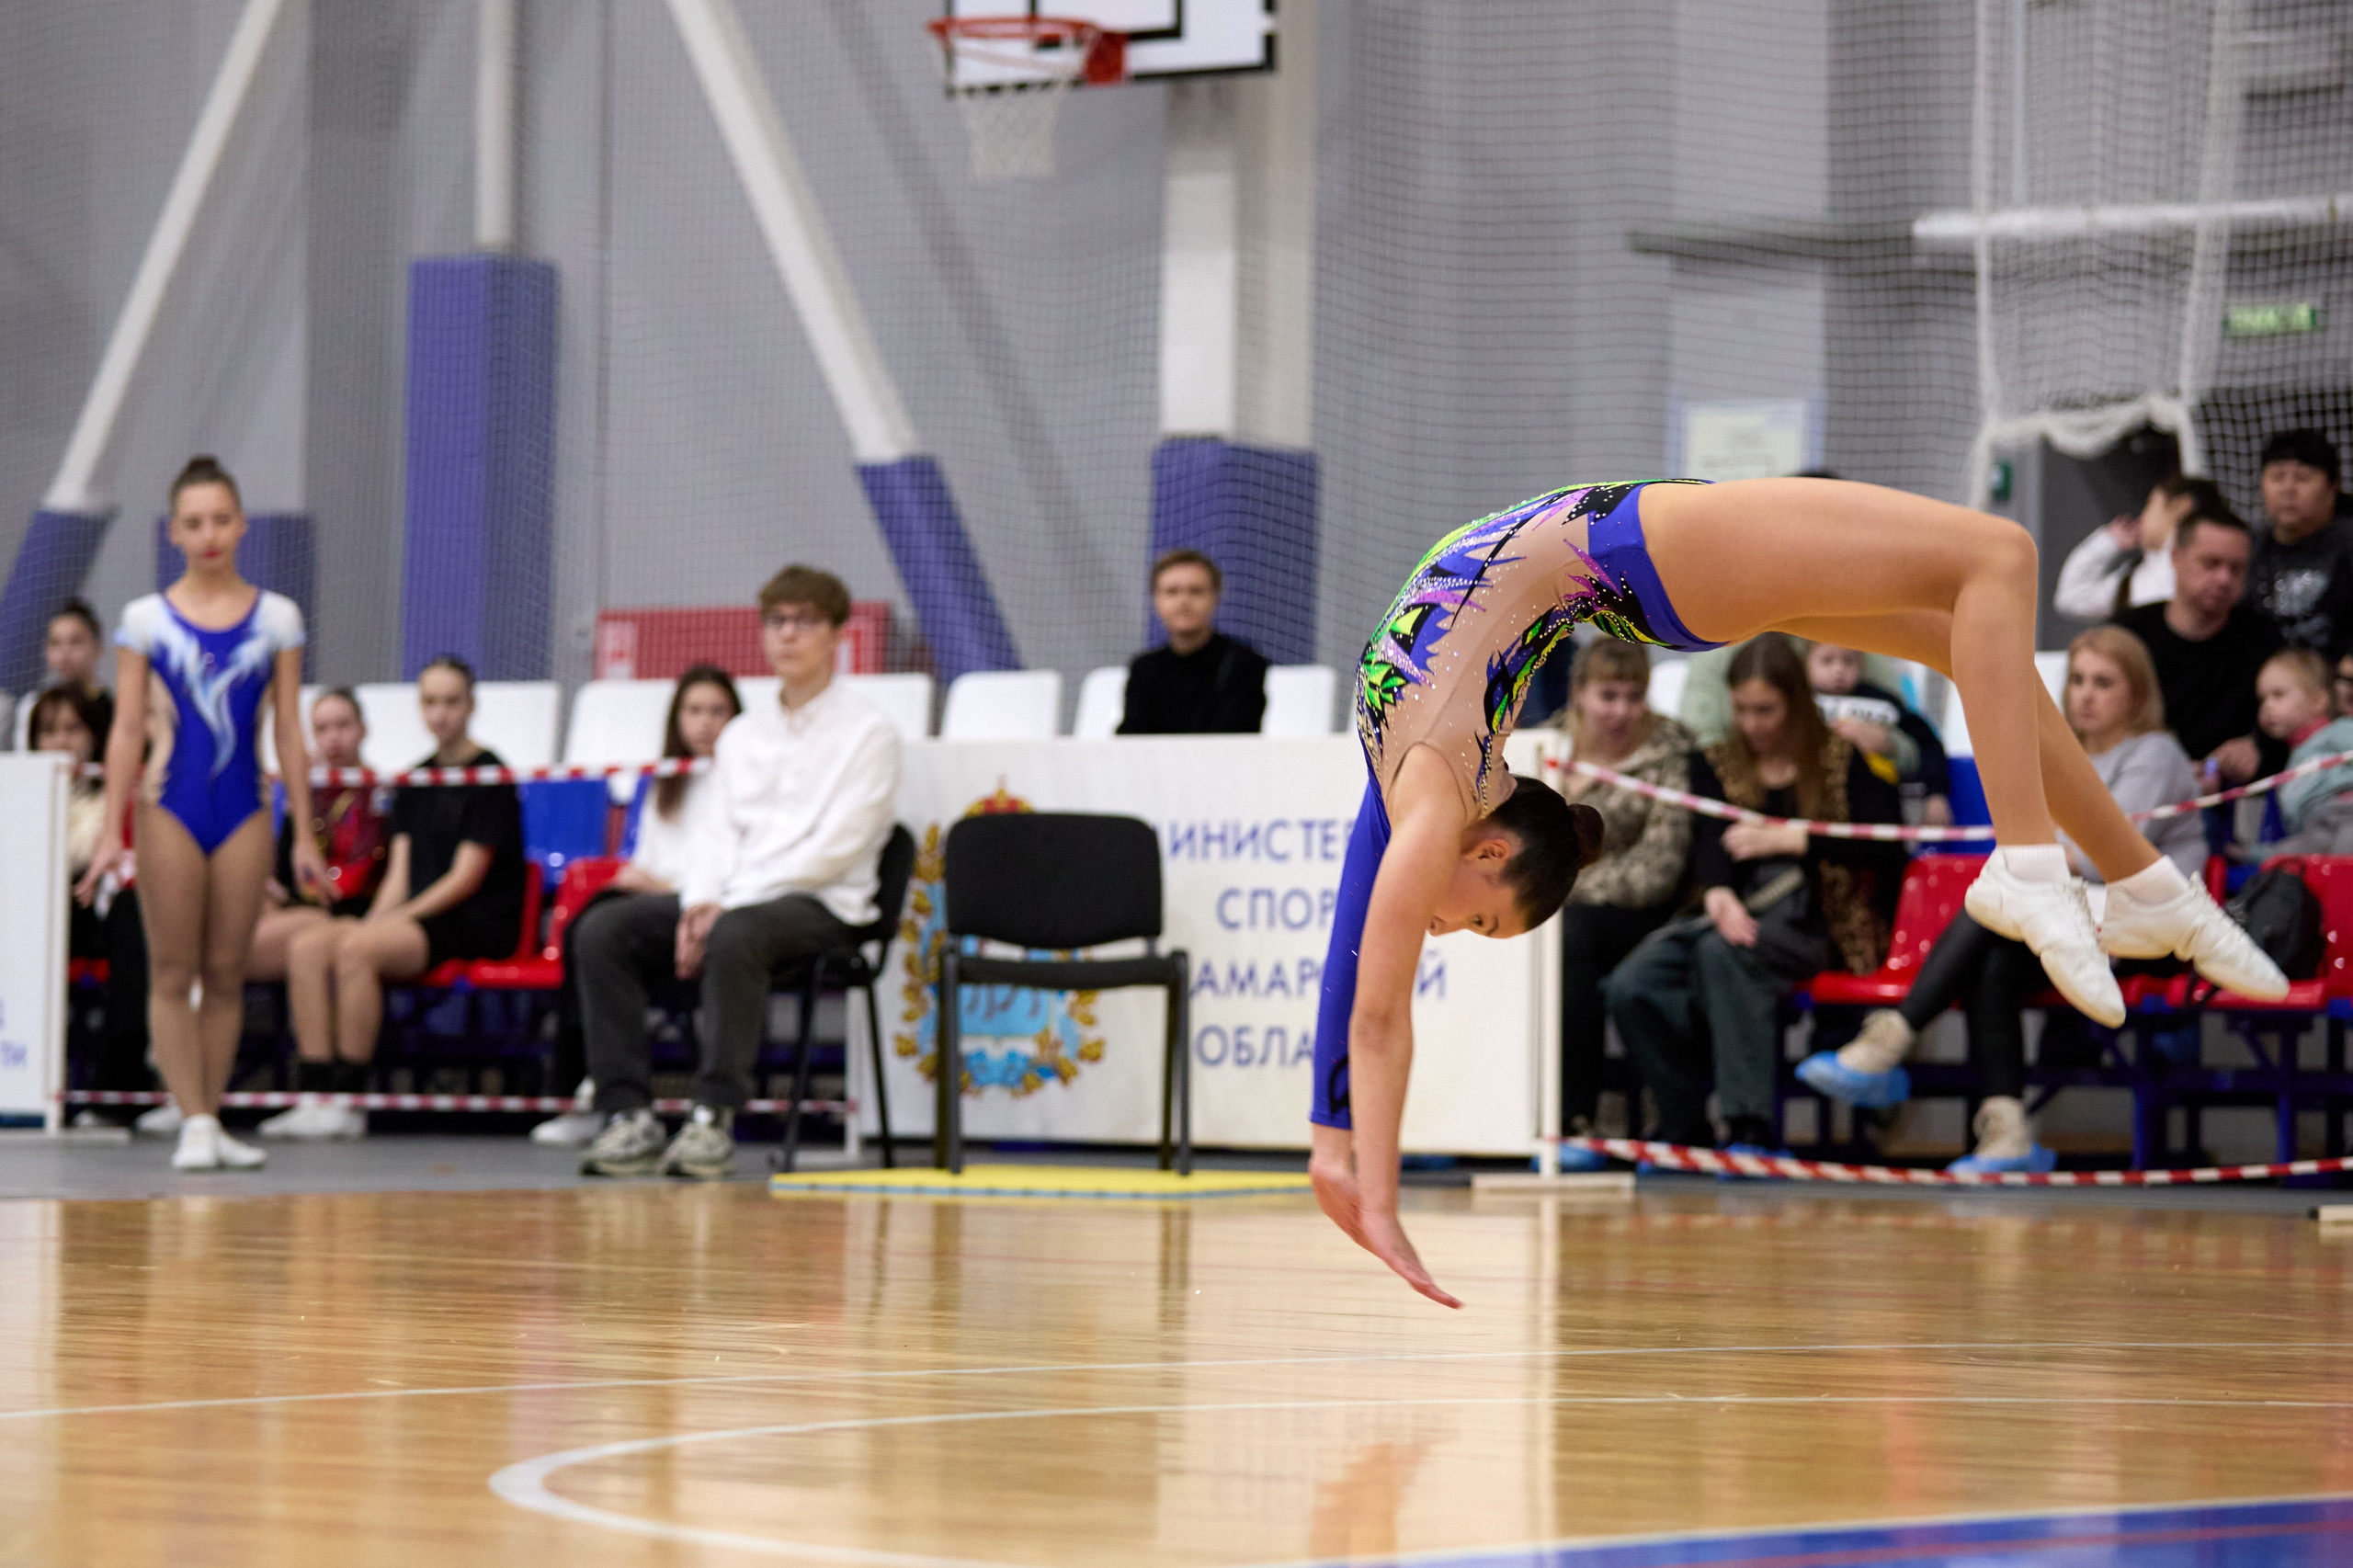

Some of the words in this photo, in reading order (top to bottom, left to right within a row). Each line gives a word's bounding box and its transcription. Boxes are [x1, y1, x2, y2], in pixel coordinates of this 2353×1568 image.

[1165, 820, 1355, 861] ИНИСТЕ
[1216, 888, 1338, 930] СПОР
[1189, 949, 1446, 1001] АМАРЙ
[1196, 1025, 1315, 1068] ОБЛА
